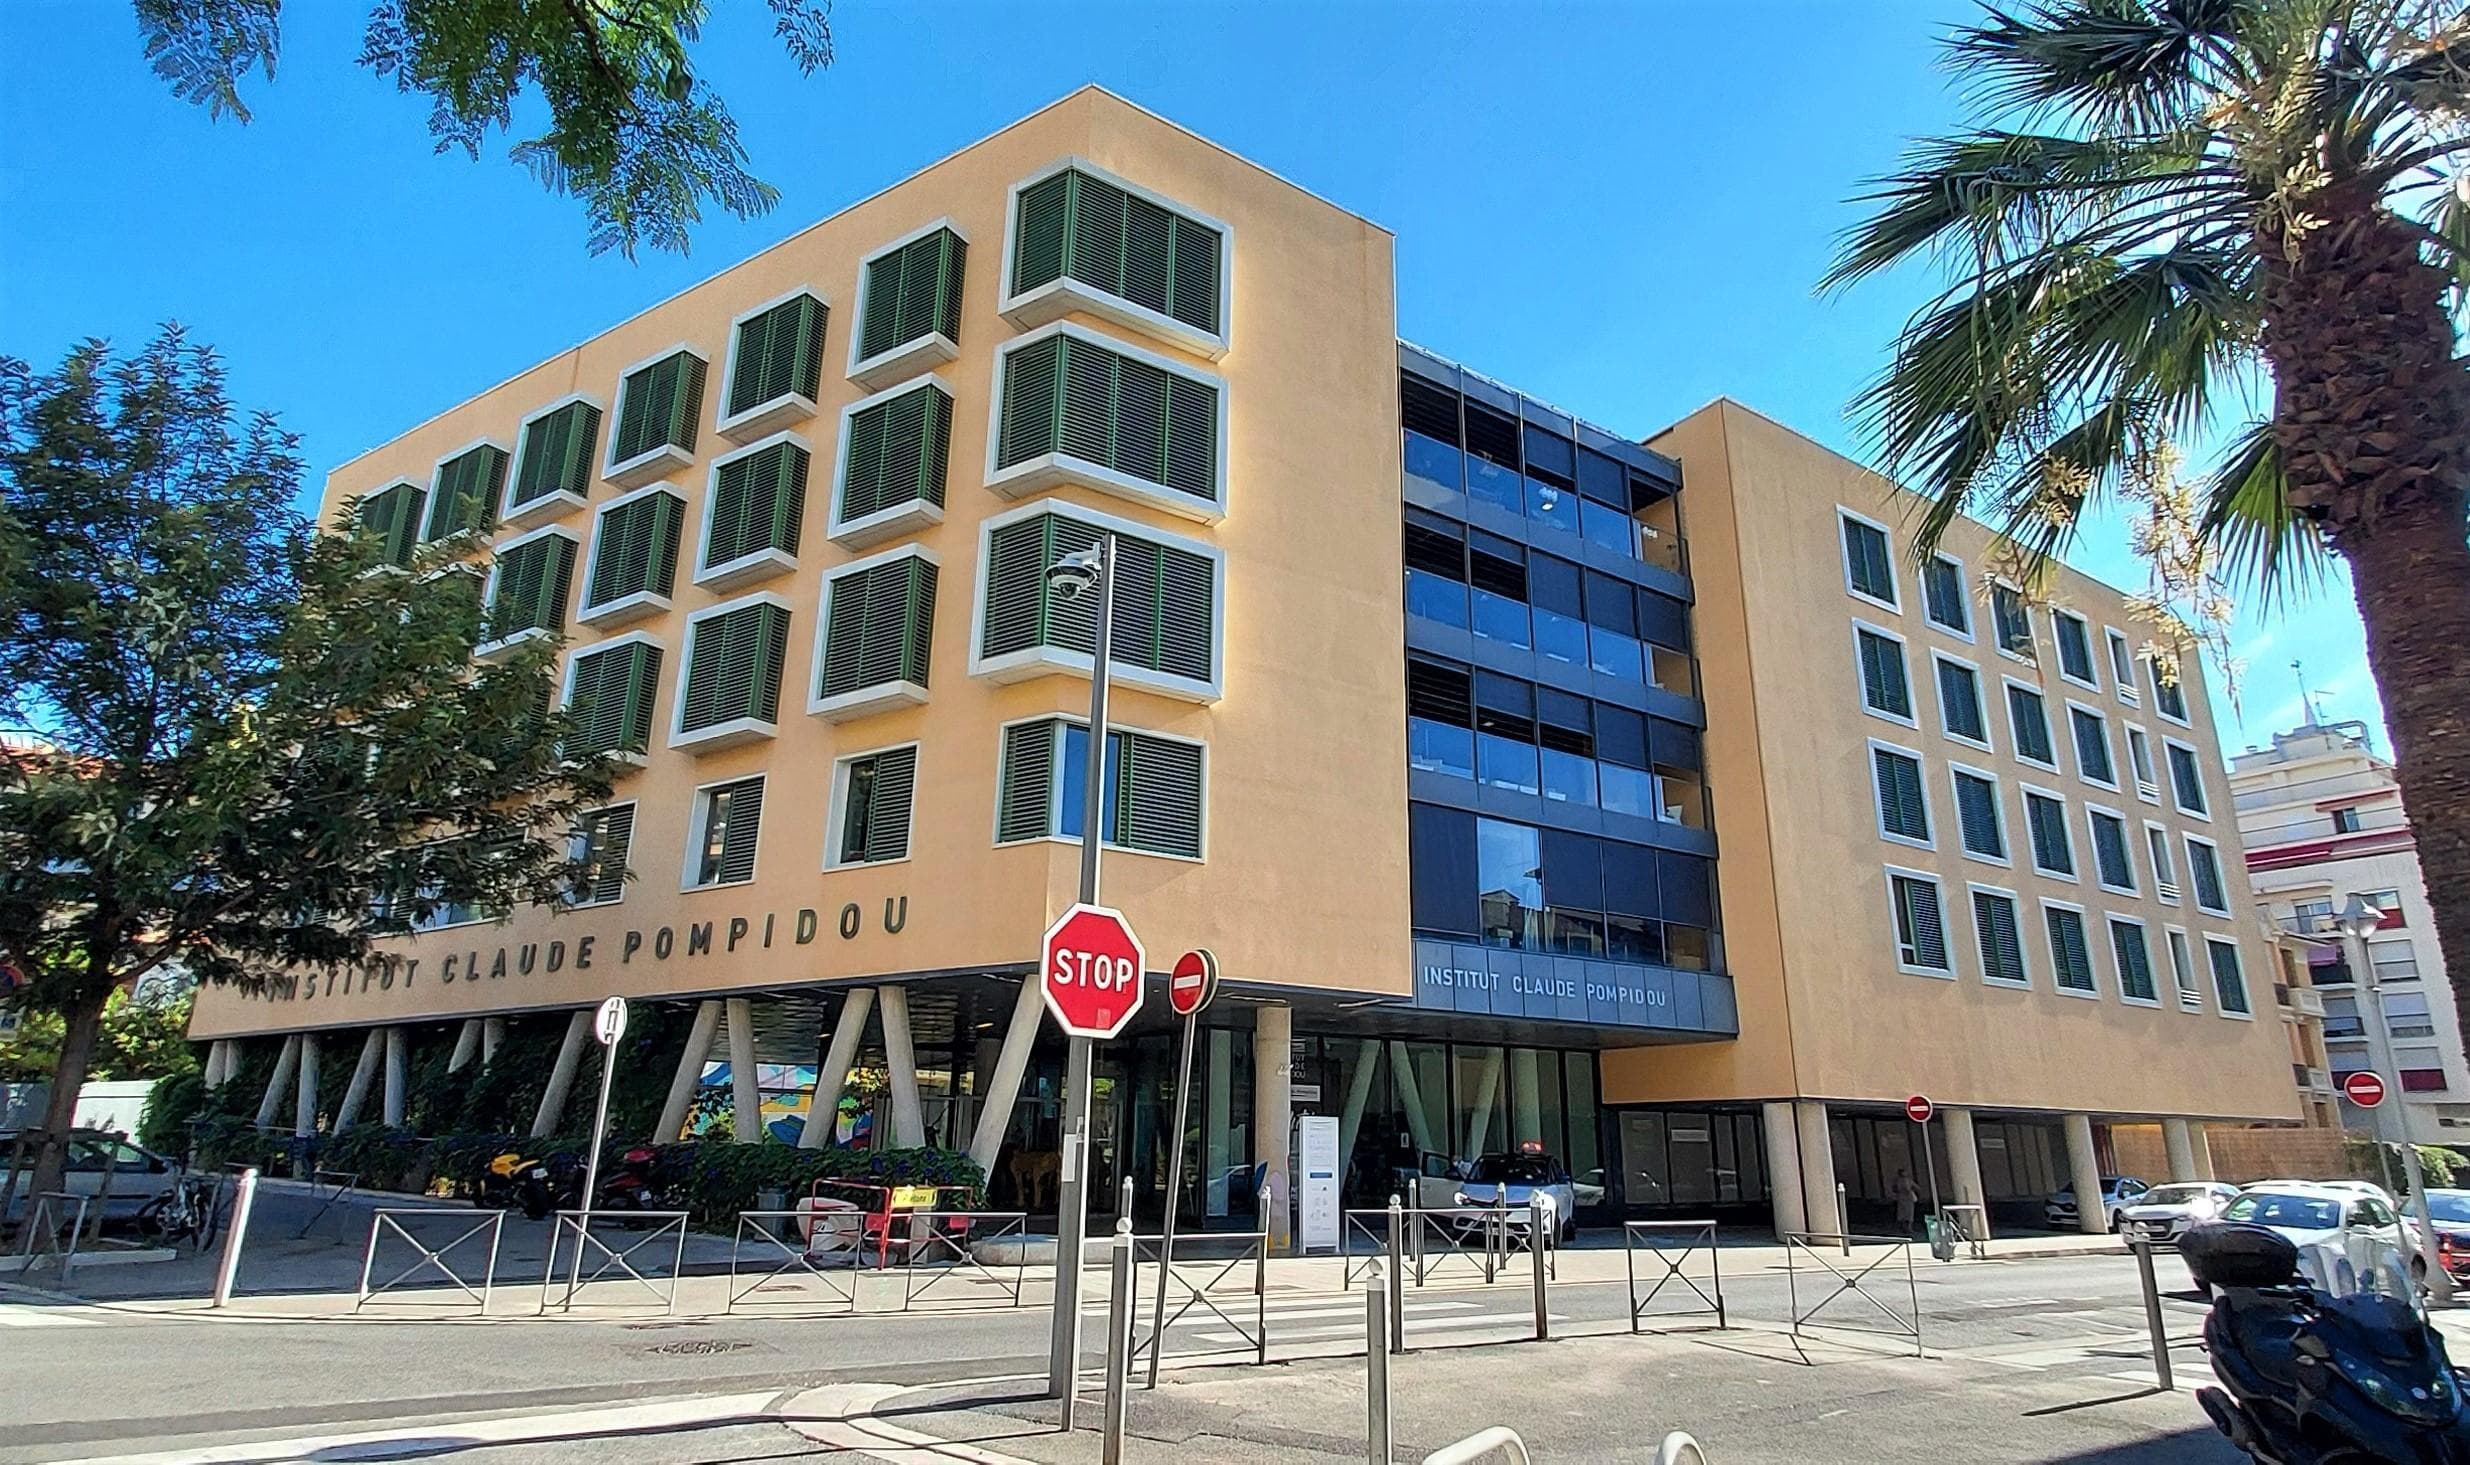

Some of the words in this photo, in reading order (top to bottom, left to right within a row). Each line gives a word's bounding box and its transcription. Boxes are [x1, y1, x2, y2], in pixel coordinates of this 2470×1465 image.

[442, 935, 595, 983] CLAUDE
[622, 896, 908, 964] POMPIDOU
[1053, 948, 1134, 992] STOP
[1424, 966, 1500, 991] INSTITUT
[1512, 975, 1576, 998] CLAUDE
[1586, 983, 1666, 1007] POMPIDOU
